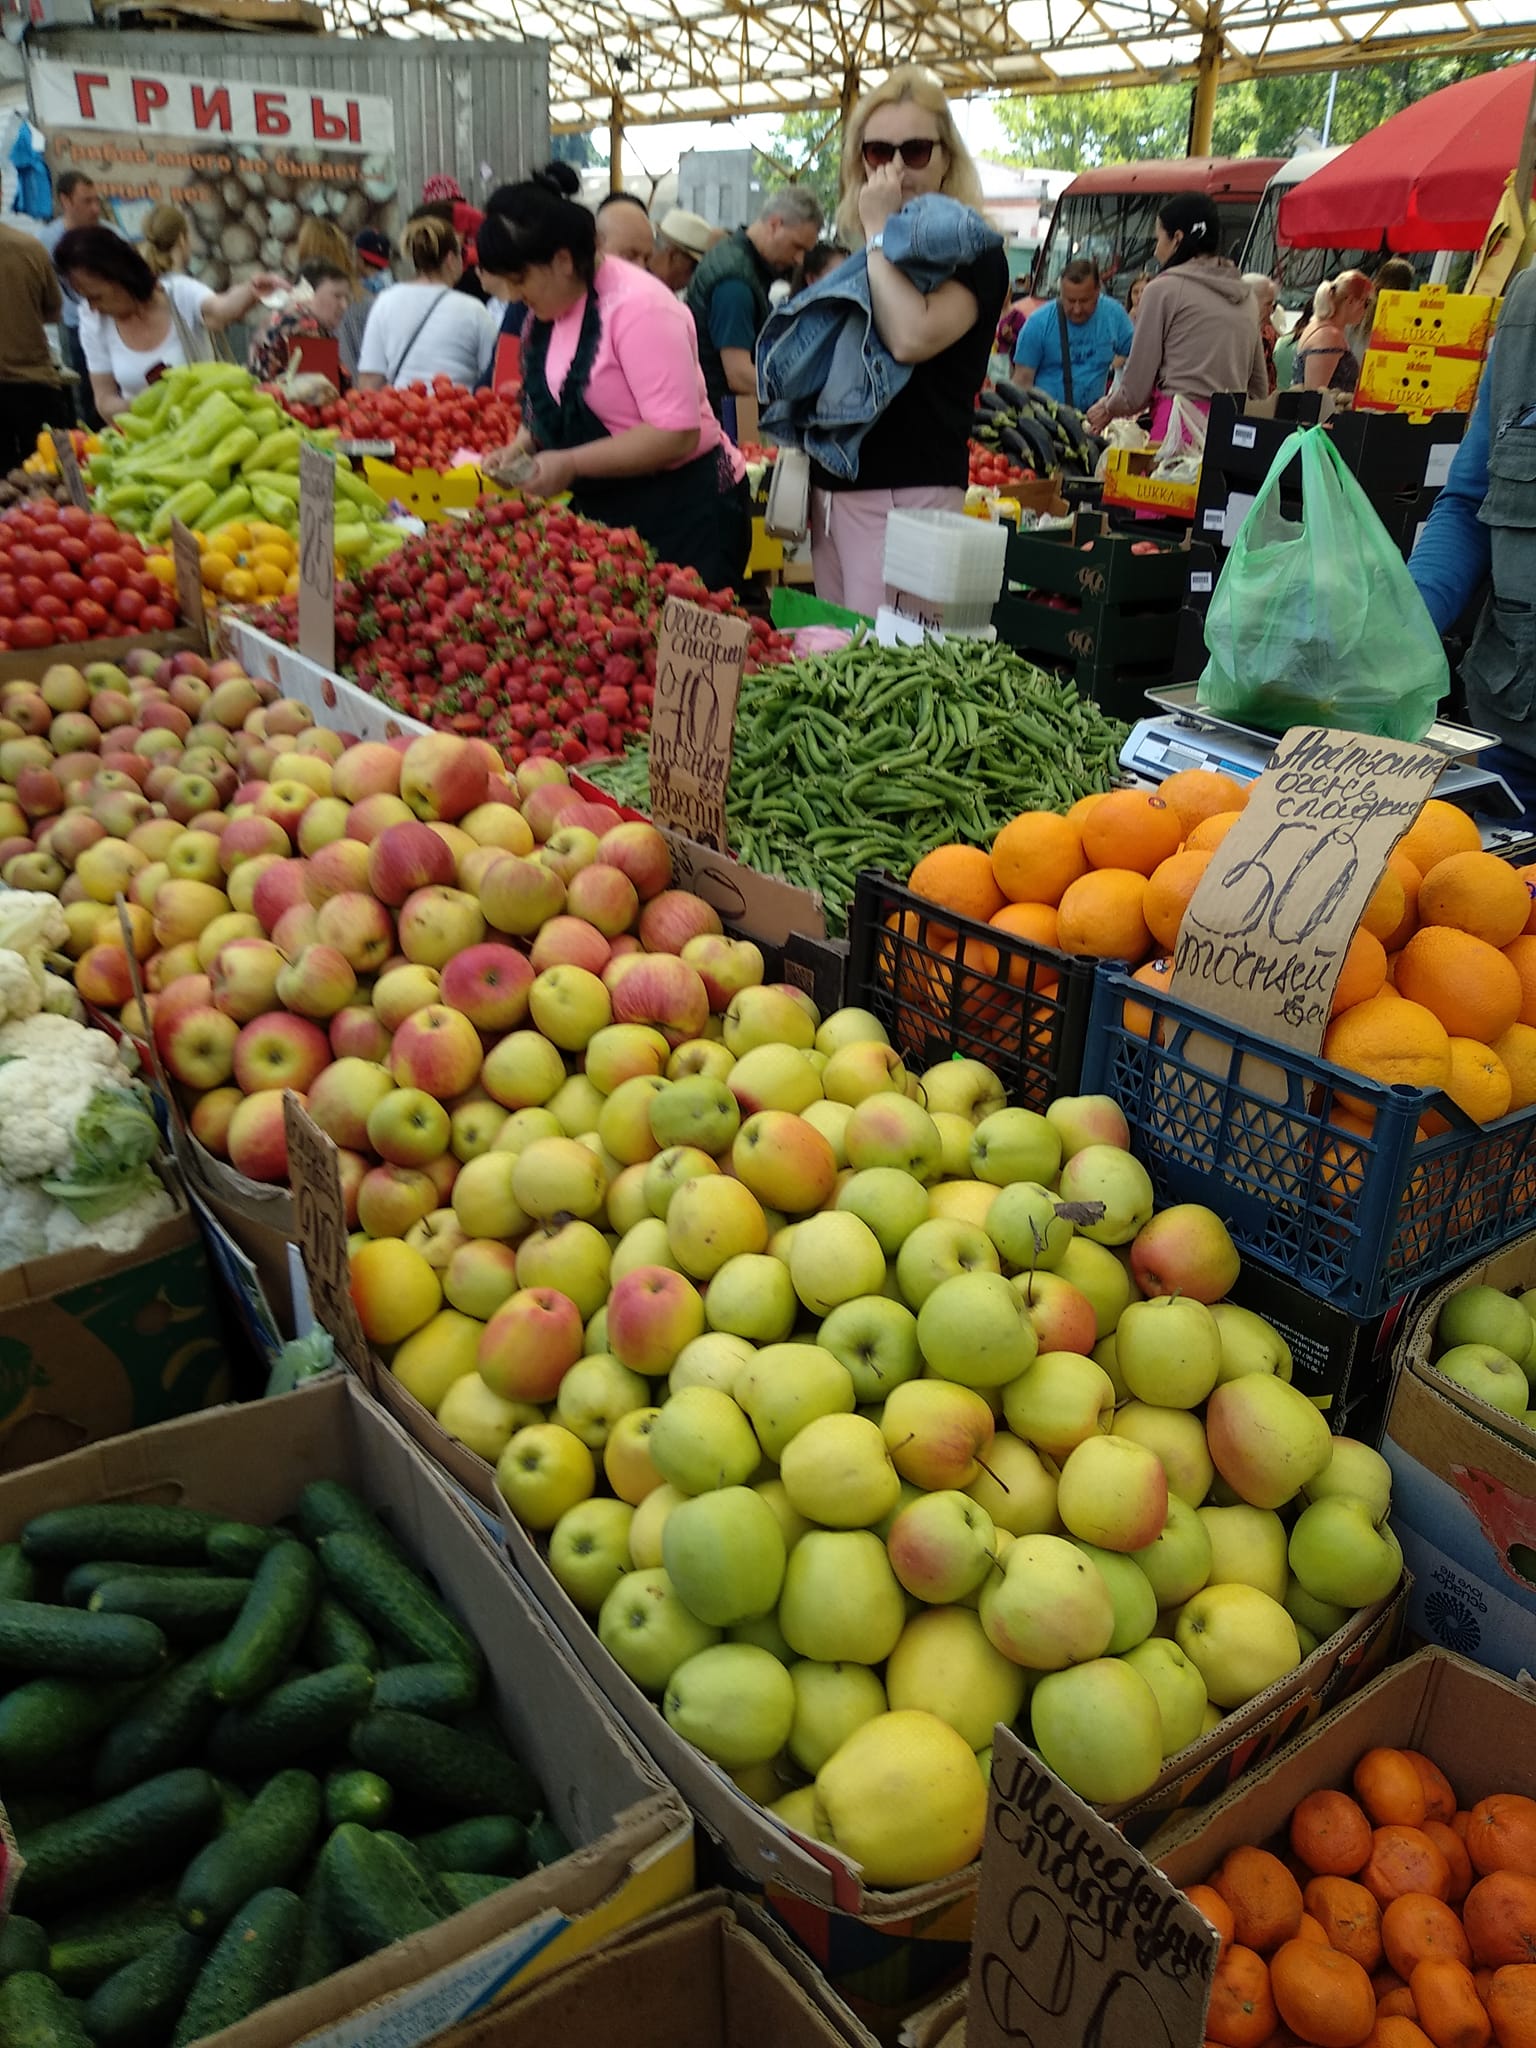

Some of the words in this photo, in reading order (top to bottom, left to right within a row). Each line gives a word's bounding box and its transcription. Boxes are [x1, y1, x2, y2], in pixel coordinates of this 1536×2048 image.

[73, 71, 362, 144] ГРИБЫ
[1402, 328, 1446, 343] LUKKA
[1389, 389, 1432, 405] LUKKA
[1137, 483, 1175, 502] LUKKA
[1189, 822, 1358, 945] 50
[1440, 1565, 1456, 1582] life
[1430, 1570, 1488, 1613] ecuador
[1458, 1578, 1483, 1601] love
